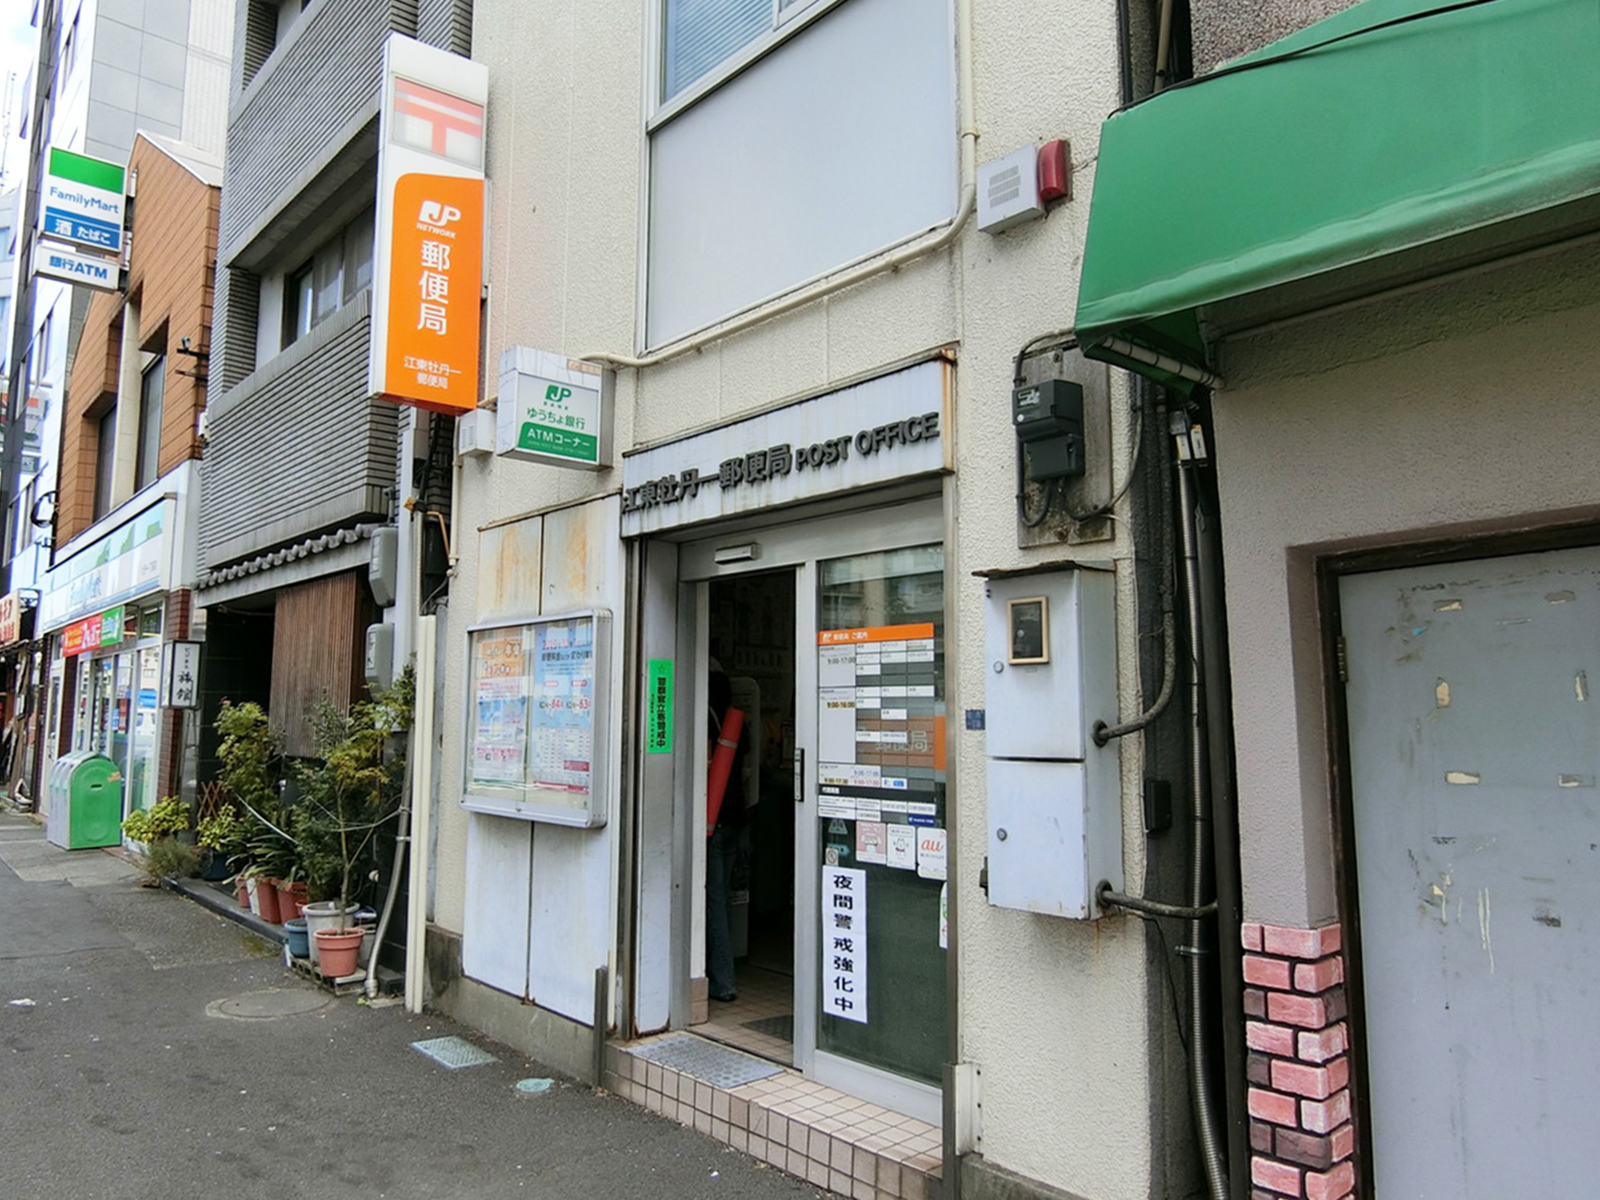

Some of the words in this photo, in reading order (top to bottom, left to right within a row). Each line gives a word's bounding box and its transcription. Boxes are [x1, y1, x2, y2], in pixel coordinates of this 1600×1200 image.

[49, 186, 119, 214] FamilyMart
[54, 218, 73, 236] 酒
[77, 226, 111, 244] たばこ
[416, 222, 456, 239] NETWORK
[49, 255, 108, 279] 銀行ATM
[417, 239, 451, 335] 郵便局
[404, 355, 462, 376] 江東牡丹一
[416, 372, 448, 389] 郵便局
[527, 407, 585, 430] ゆうちょ銀行
[527, 428, 590, 448] ATMコーナー
[796, 435, 852, 473] POST
[855, 411, 941, 456] OFFICE
[920, 839, 944, 852] au
[833, 874, 854, 1012] 夜間警戒強化中
